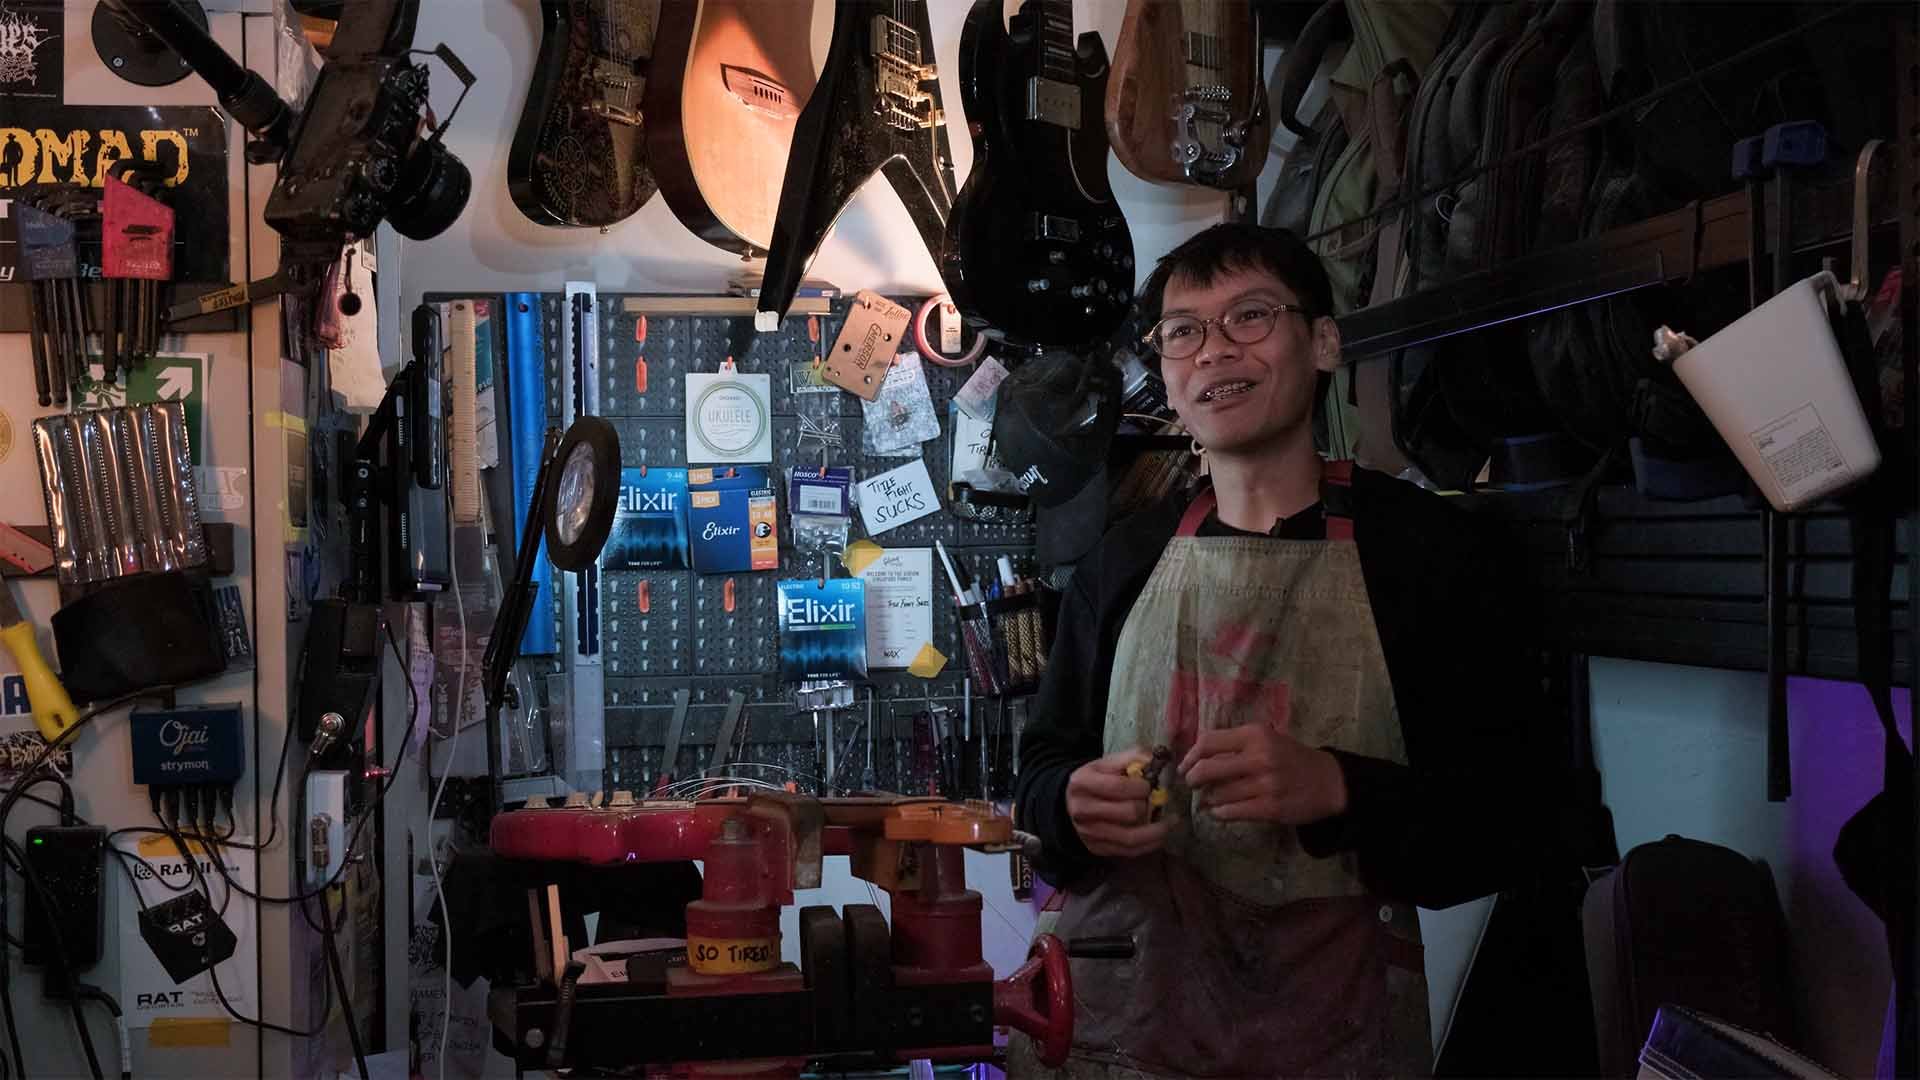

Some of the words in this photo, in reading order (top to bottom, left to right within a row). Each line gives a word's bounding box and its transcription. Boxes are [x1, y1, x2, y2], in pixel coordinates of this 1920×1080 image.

[875, 492, 926, 523] SUCKS
[702, 521, 740, 541] Elixir
[788, 598, 855, 624] Elixir
[160, 719, 208, 757] Ojai
[160, 760, 208, 772] strymon
[168, 913, 204, 933] RAT
[696, 944, 719, 962] SO
[137, 991, 183, 1006] RAT
